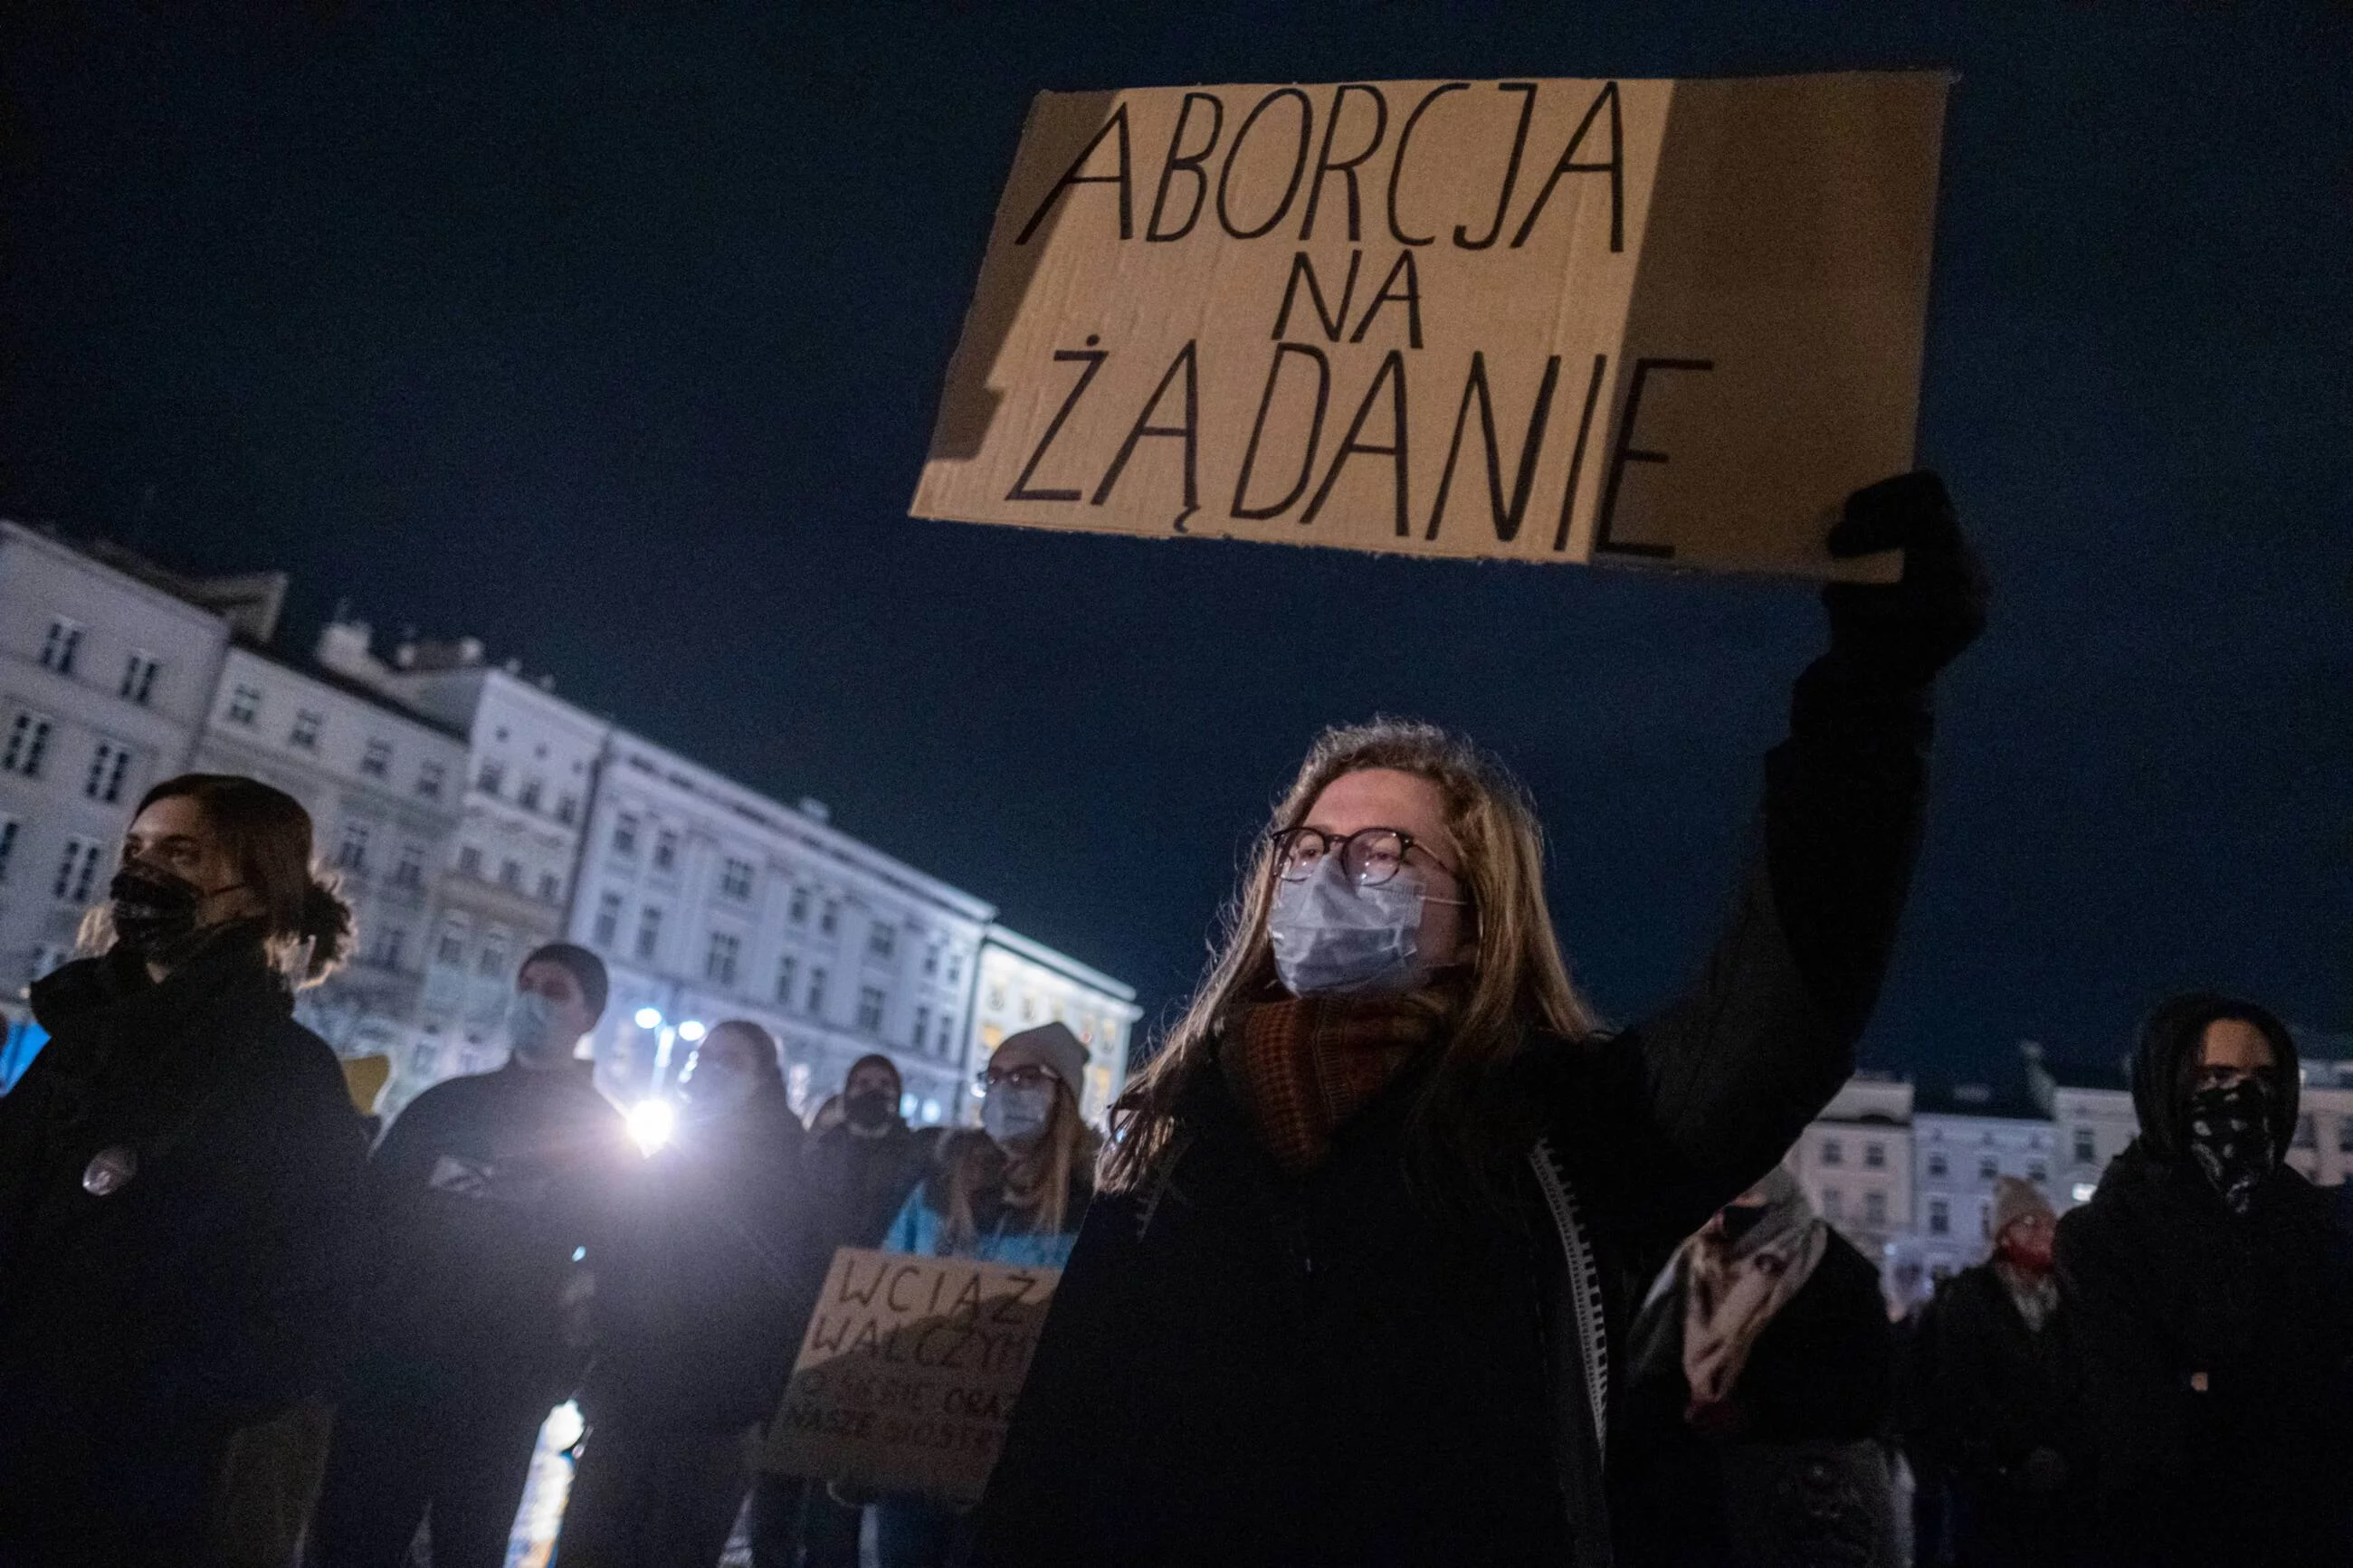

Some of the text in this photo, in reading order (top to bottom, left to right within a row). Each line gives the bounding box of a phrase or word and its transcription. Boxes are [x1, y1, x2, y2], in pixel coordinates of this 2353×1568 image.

[1014, 81, 1626, 253] ABORCJA
[1271, 249, 1424, 350] NA
[1004, 333, 1714, 559] ŻĄDANIE
[810, 1315, 1039, 1372] WALCZYM
